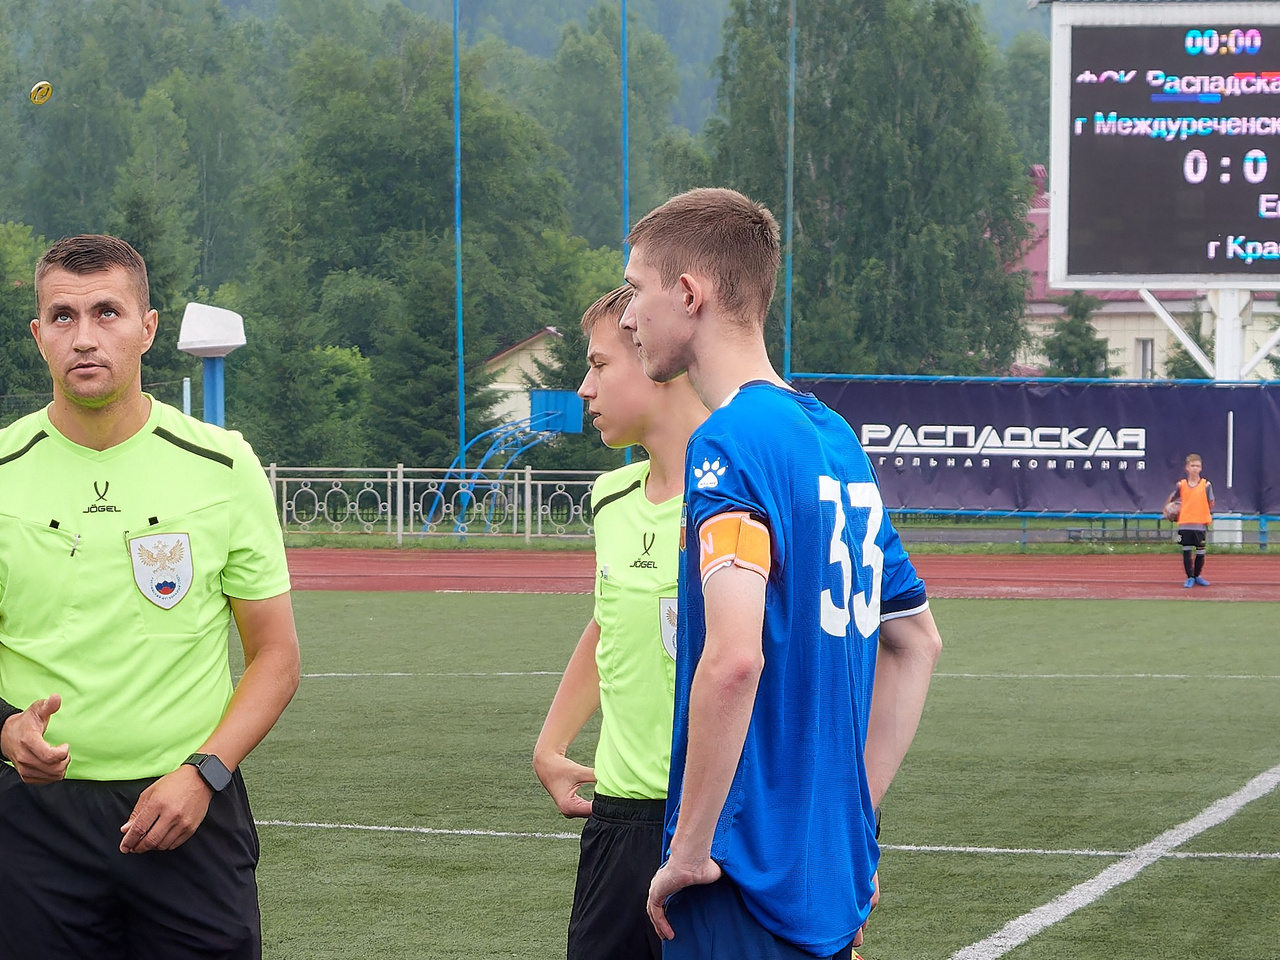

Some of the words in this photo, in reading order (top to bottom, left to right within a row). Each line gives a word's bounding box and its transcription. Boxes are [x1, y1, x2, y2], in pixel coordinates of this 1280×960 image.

[1185, 29, 1262, 55] 00:00
[1225, 235, 1280, 264] Кра
[861, 424, 1146, 457] РАСПАДСКАЯ
[877, 456, 991, 468] ГОЛЬНАЯ
[1011, 458, 1146, 471] КОМПАНИЯ
[82, 504, 122, 513] JÖGEL
[629, 558, 658, 569] JÖGEL
[818, 475, 884, 639] 33
